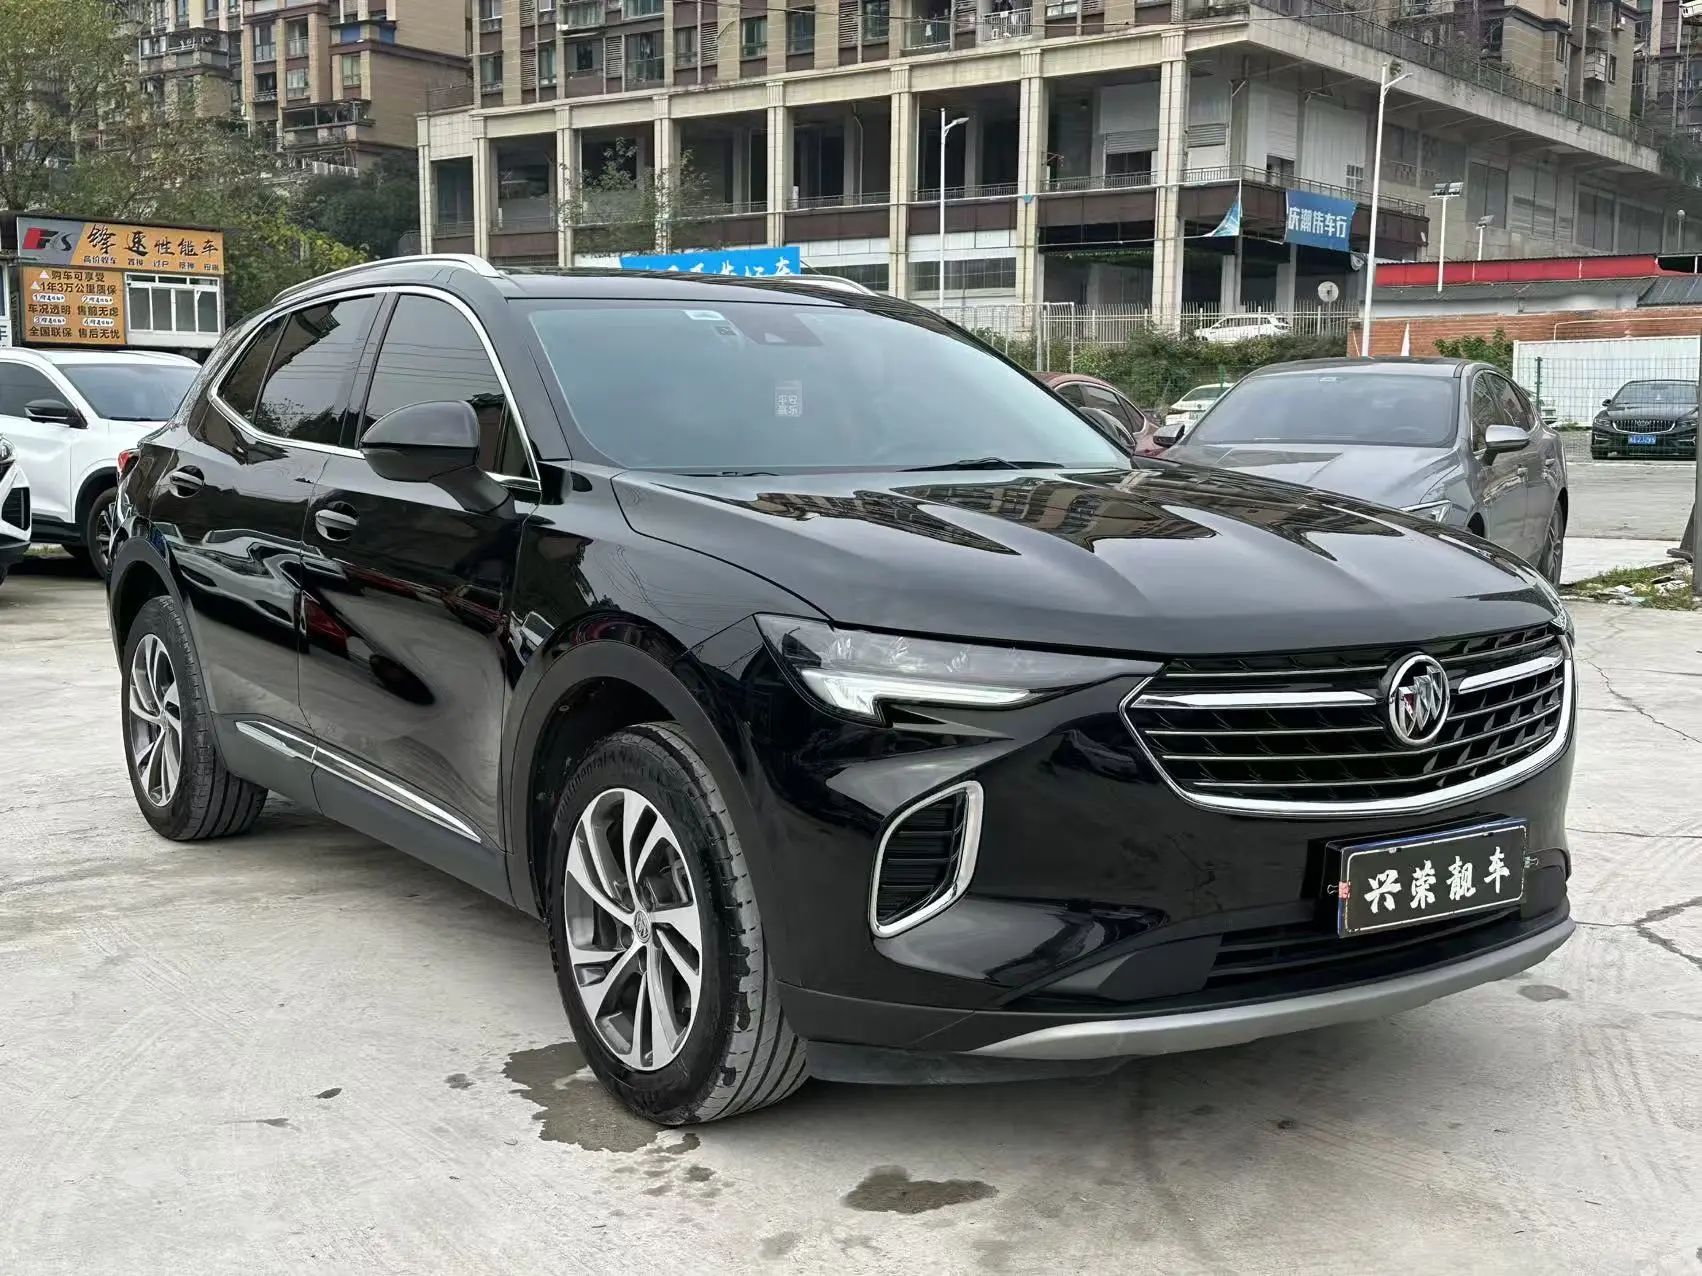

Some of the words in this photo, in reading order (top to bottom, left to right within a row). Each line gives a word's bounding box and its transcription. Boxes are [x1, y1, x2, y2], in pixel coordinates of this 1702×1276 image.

[51, 270, 105, 283] 购车可享受
[40, 281, 117, 296] 1年3万公里质保
[28, 303, 71, 315] 车况透明
[29, 326, 73, 338] 全国联保
[78, 328, 121, 339] 售后无忧
[1363, 845, 1511, 914] 兴荣靓车
